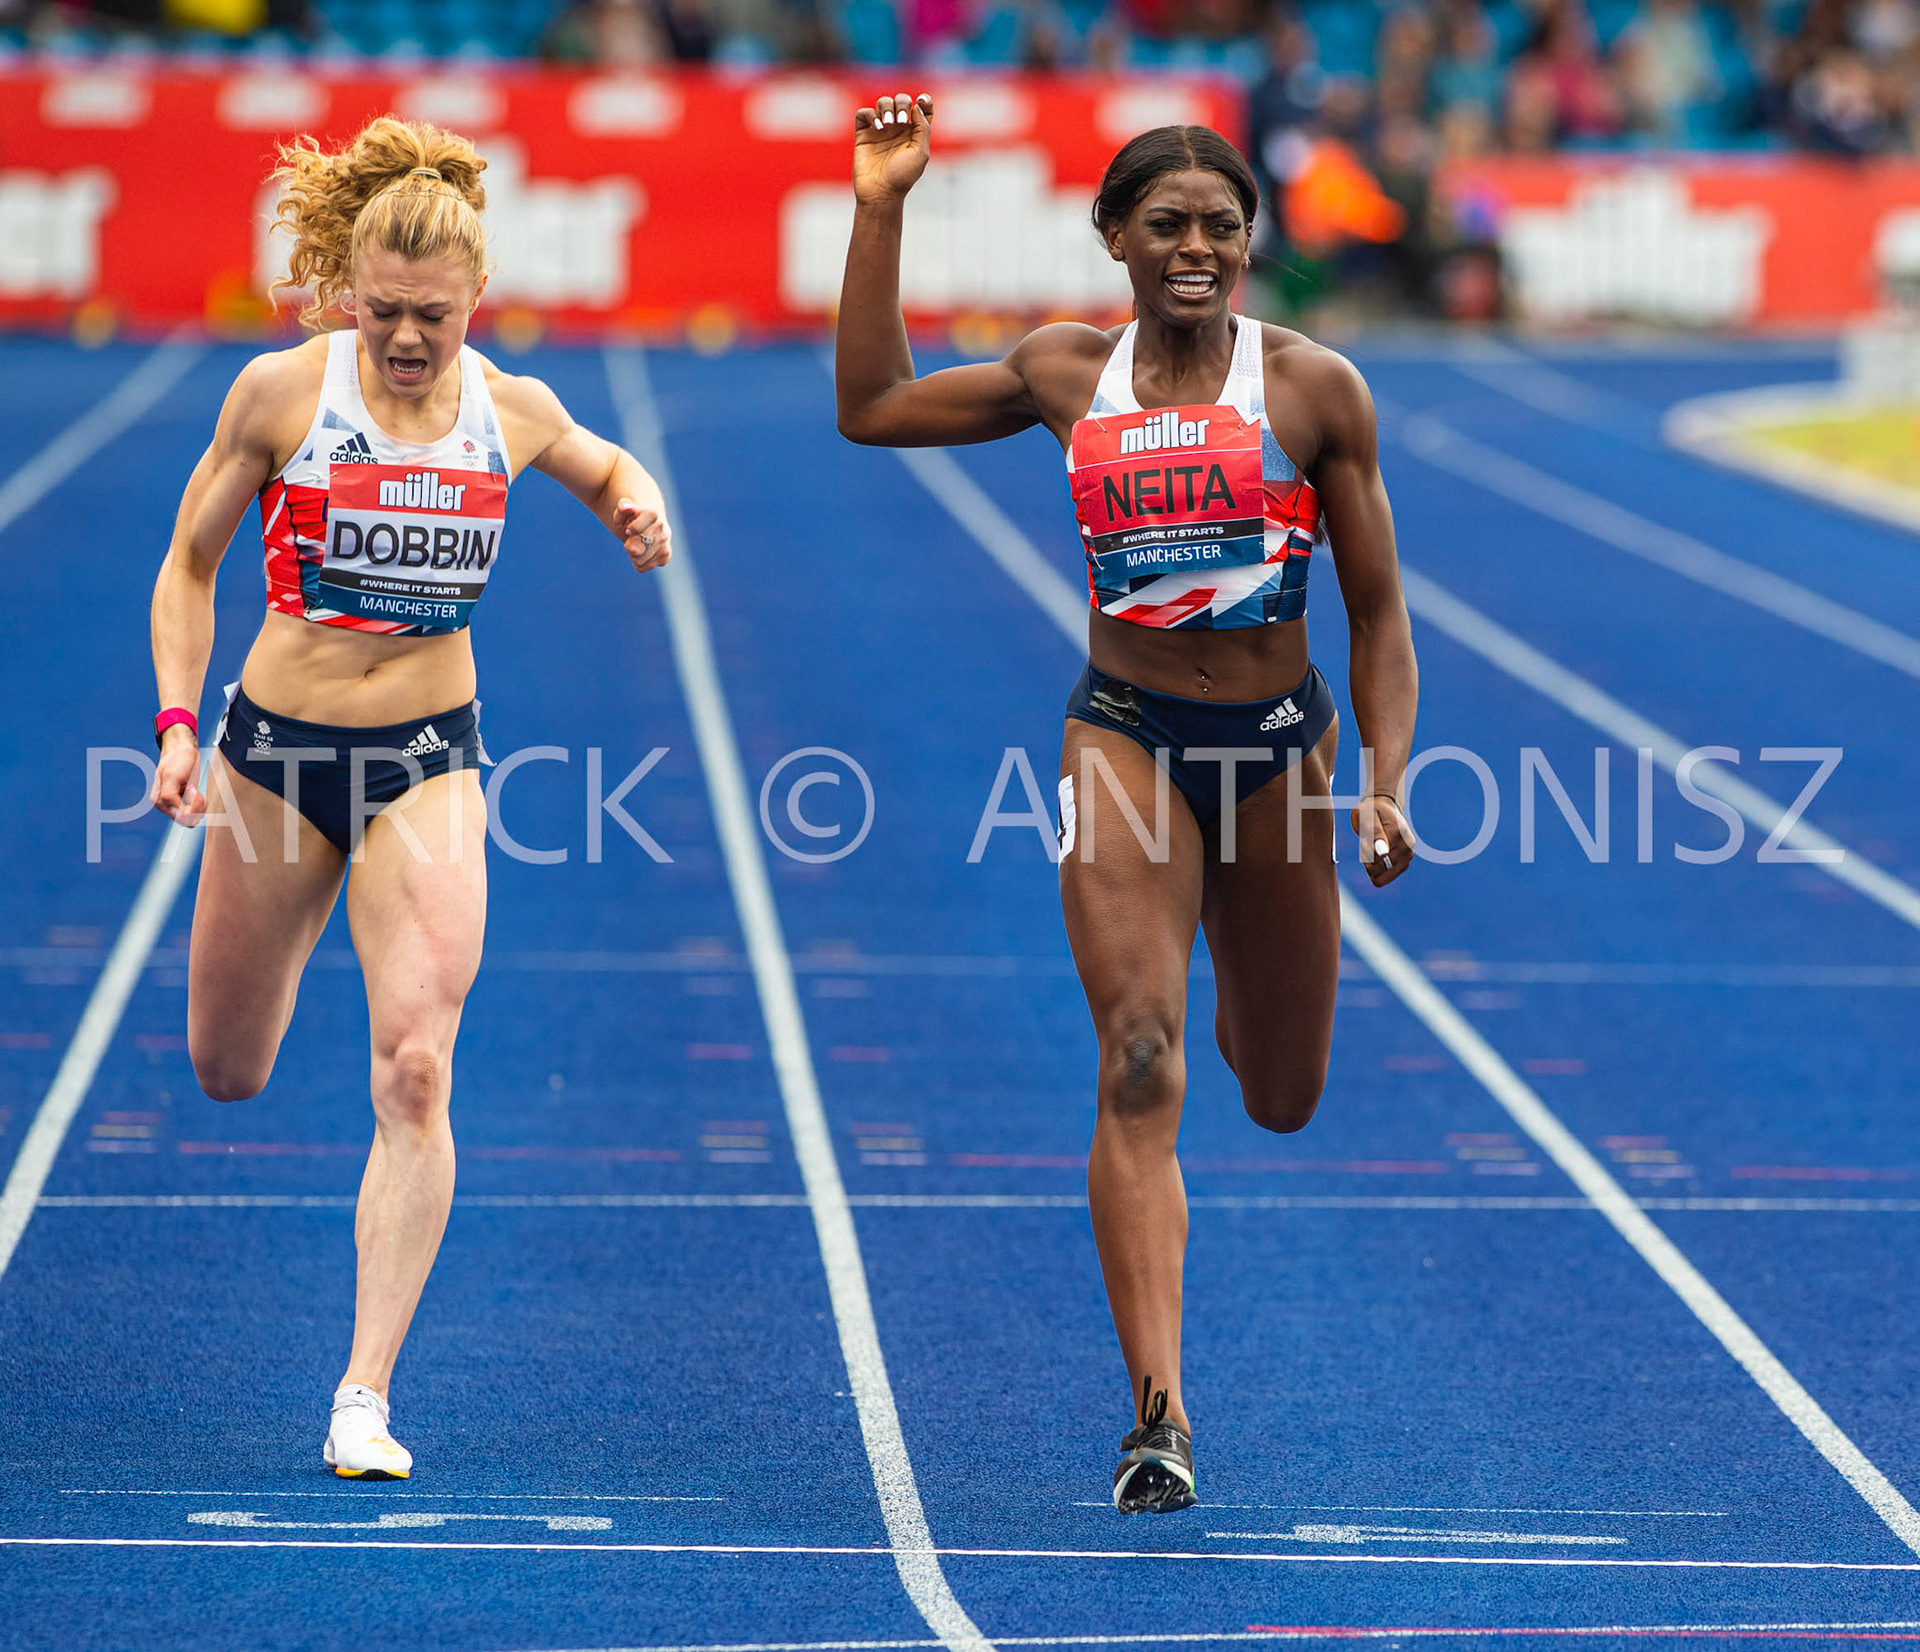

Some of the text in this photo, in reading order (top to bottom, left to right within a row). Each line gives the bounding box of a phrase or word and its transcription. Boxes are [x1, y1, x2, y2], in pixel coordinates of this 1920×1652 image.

[1120, 411, 1210, 455] müller
[329, 450, 379, 464] adidas
[379, 471, 467, 511] müller
[1103, 464, 1236, 522] NEITA
[332, 520, 496, 570] DOBBIN
[1122, 526, 1224, 544] #WHERE IT STARTS
[1126, 544, 1222, 568] MANCHESTER
[360, 578, 461, 596] #WHERE IT STARTS
[360, 595, 457, 619] MANCHESTER
[1259, 710, 1305, 731] adidas
[402, 738, 450, 757] adidas
